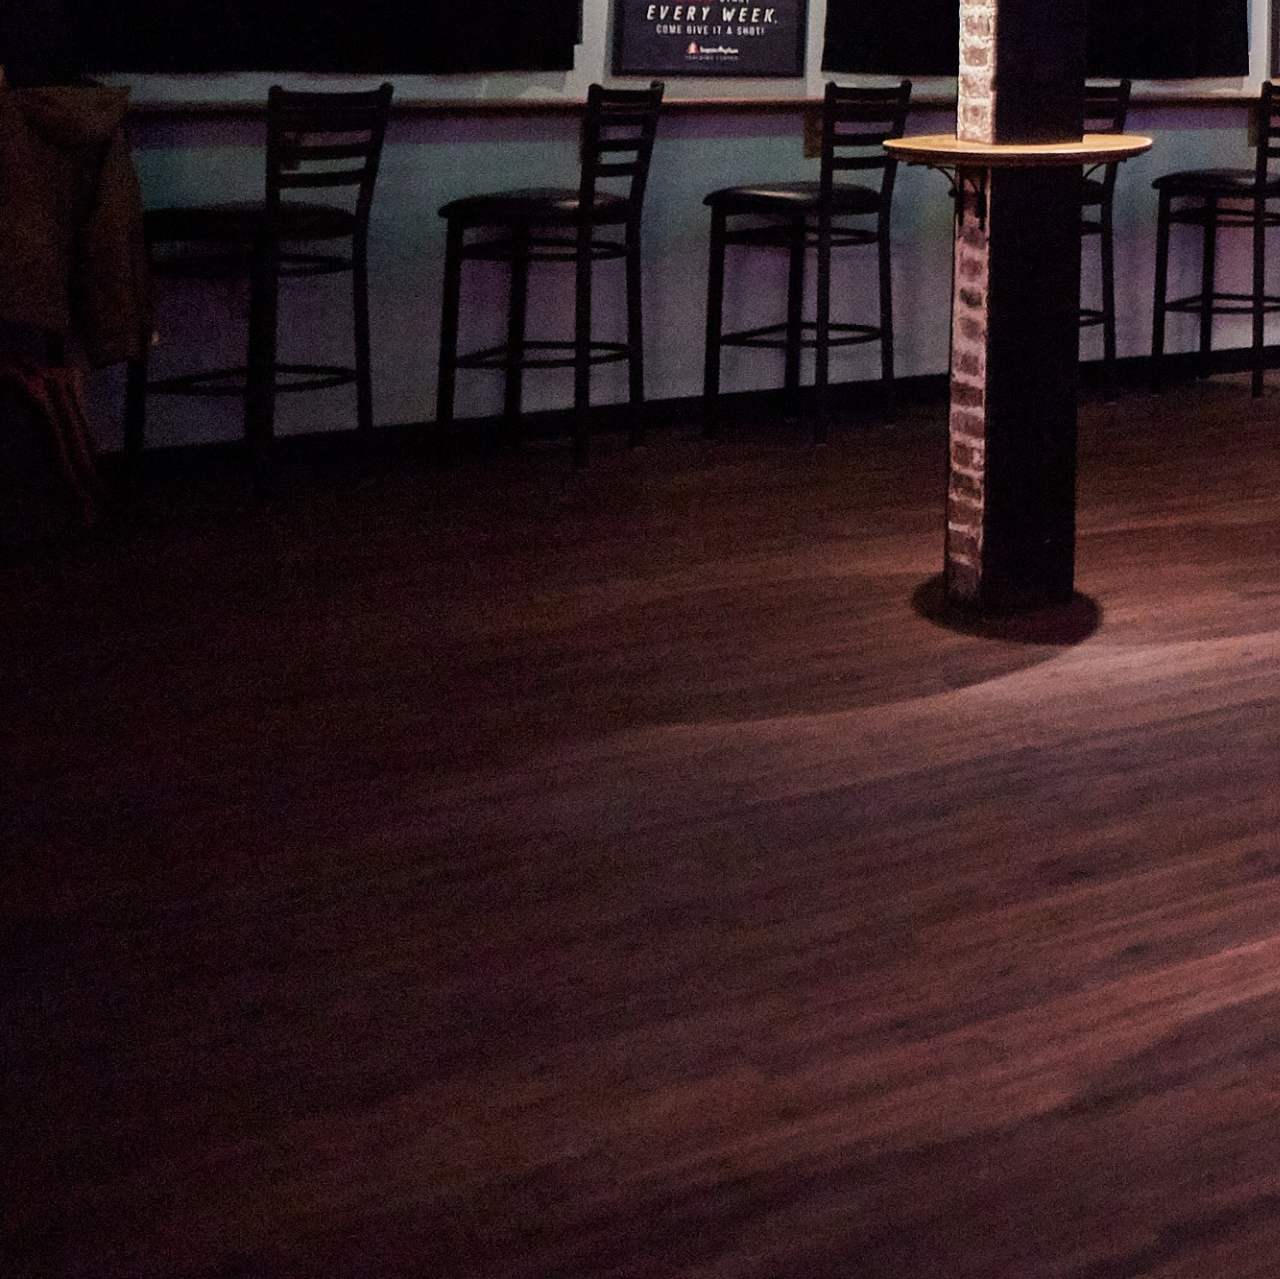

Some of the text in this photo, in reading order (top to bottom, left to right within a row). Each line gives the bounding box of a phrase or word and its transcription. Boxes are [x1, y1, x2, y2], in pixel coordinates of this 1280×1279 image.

[646, 4, 712, 22] EVERY
[656, 24, 764, 36] COME GIVE IT A SHOT!
